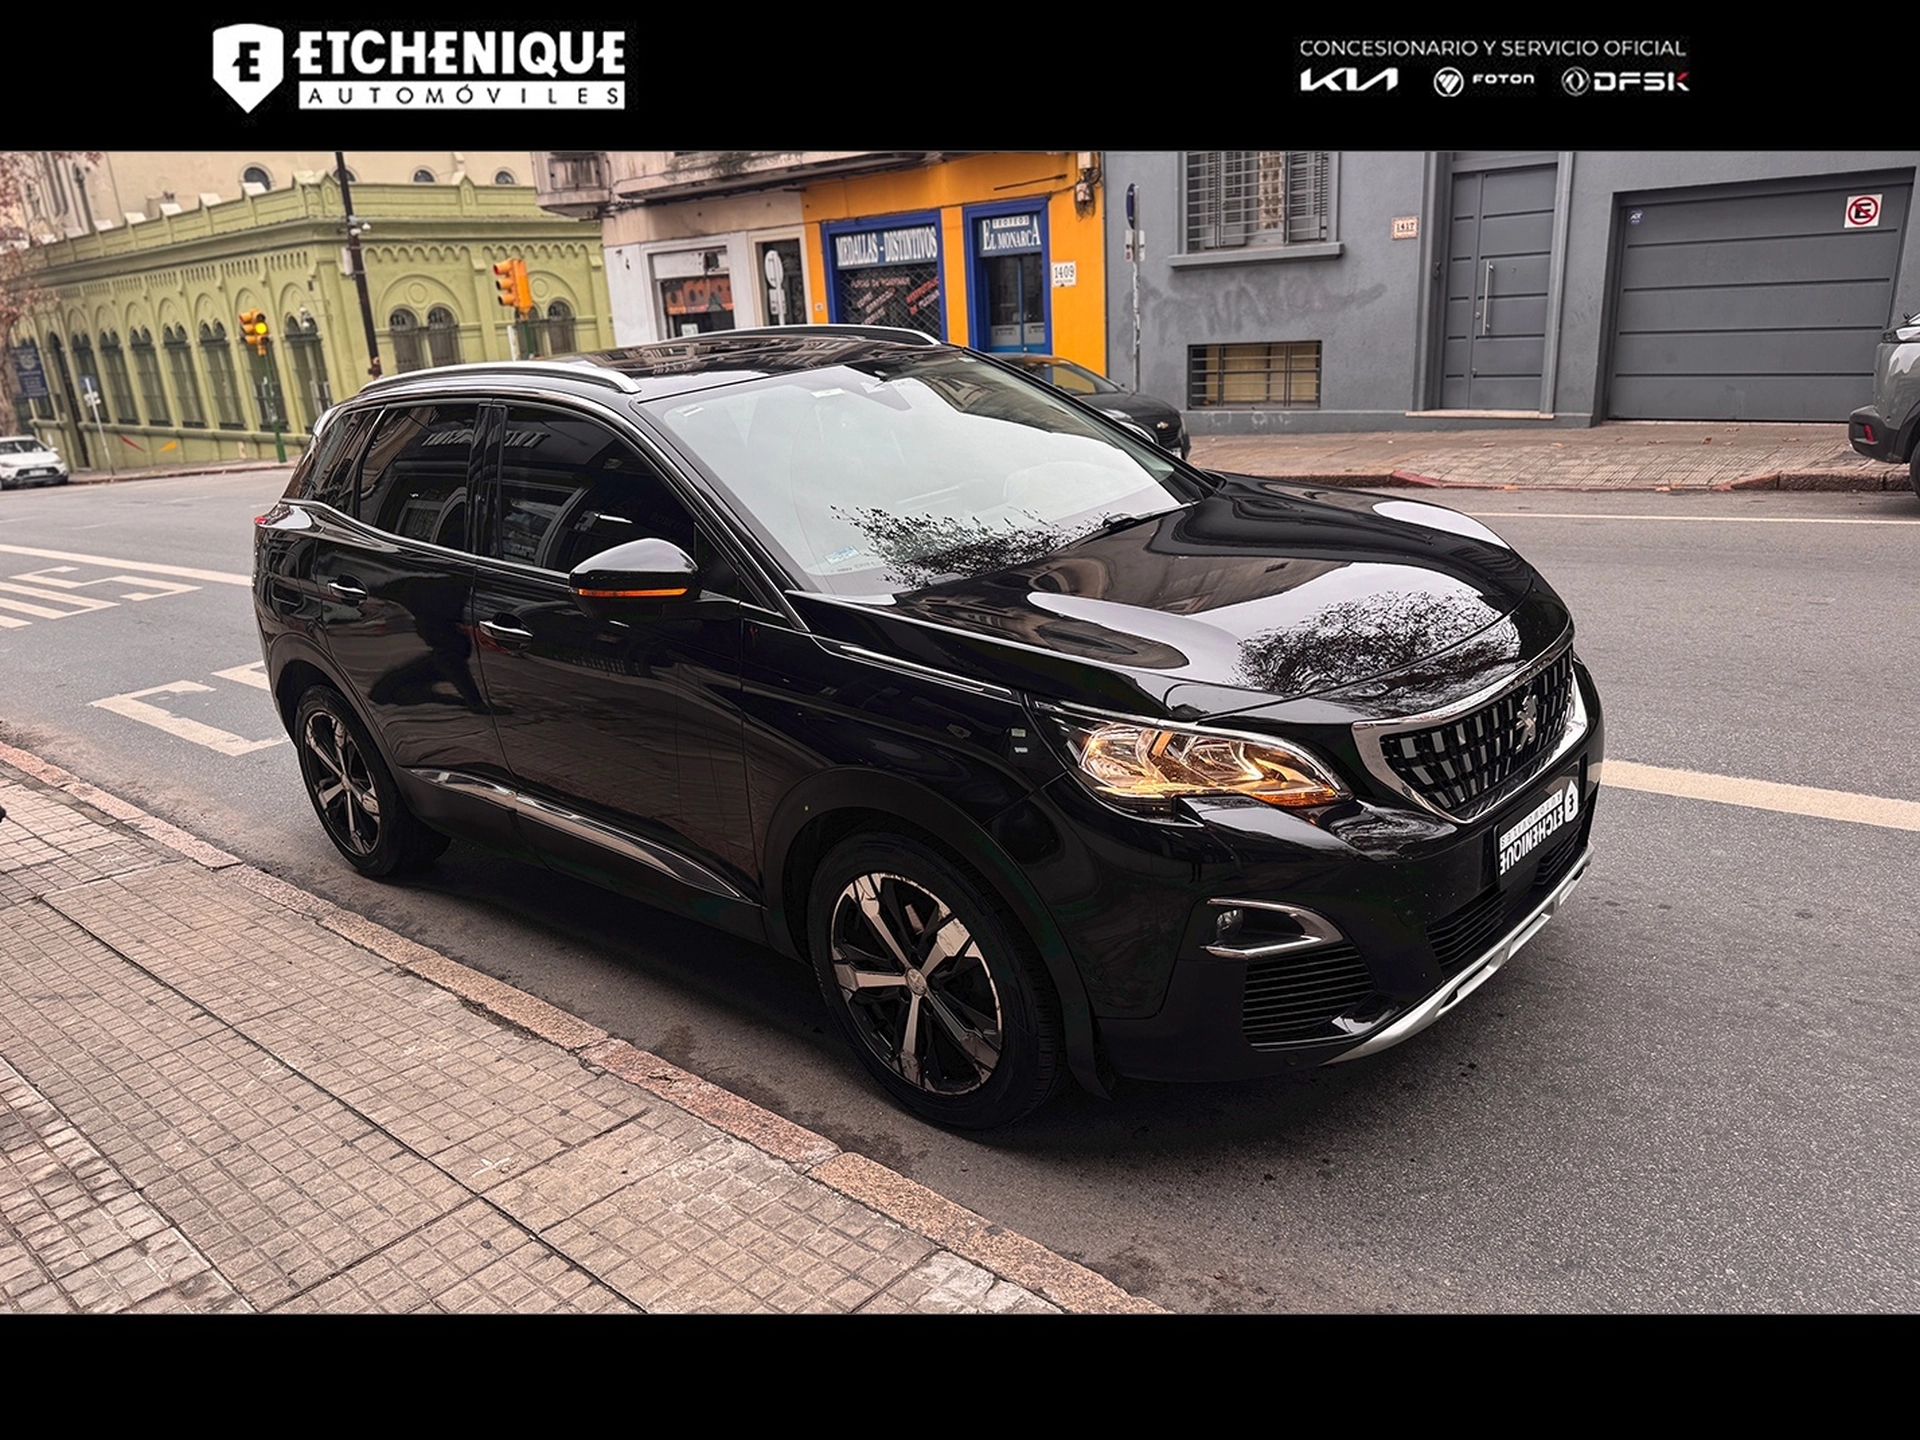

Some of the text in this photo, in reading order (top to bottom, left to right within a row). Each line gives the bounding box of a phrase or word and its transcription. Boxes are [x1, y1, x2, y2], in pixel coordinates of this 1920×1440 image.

[836, 226, 938, 266] MEDALLAS DISTINTIVOS
[997, 215, 1041, 250] MONARCA
[1054, 265, 1075, 279] 1409
[0, 565, 204, 629] US
[1500, 804, 1564, 876] ETCHENIQUE
